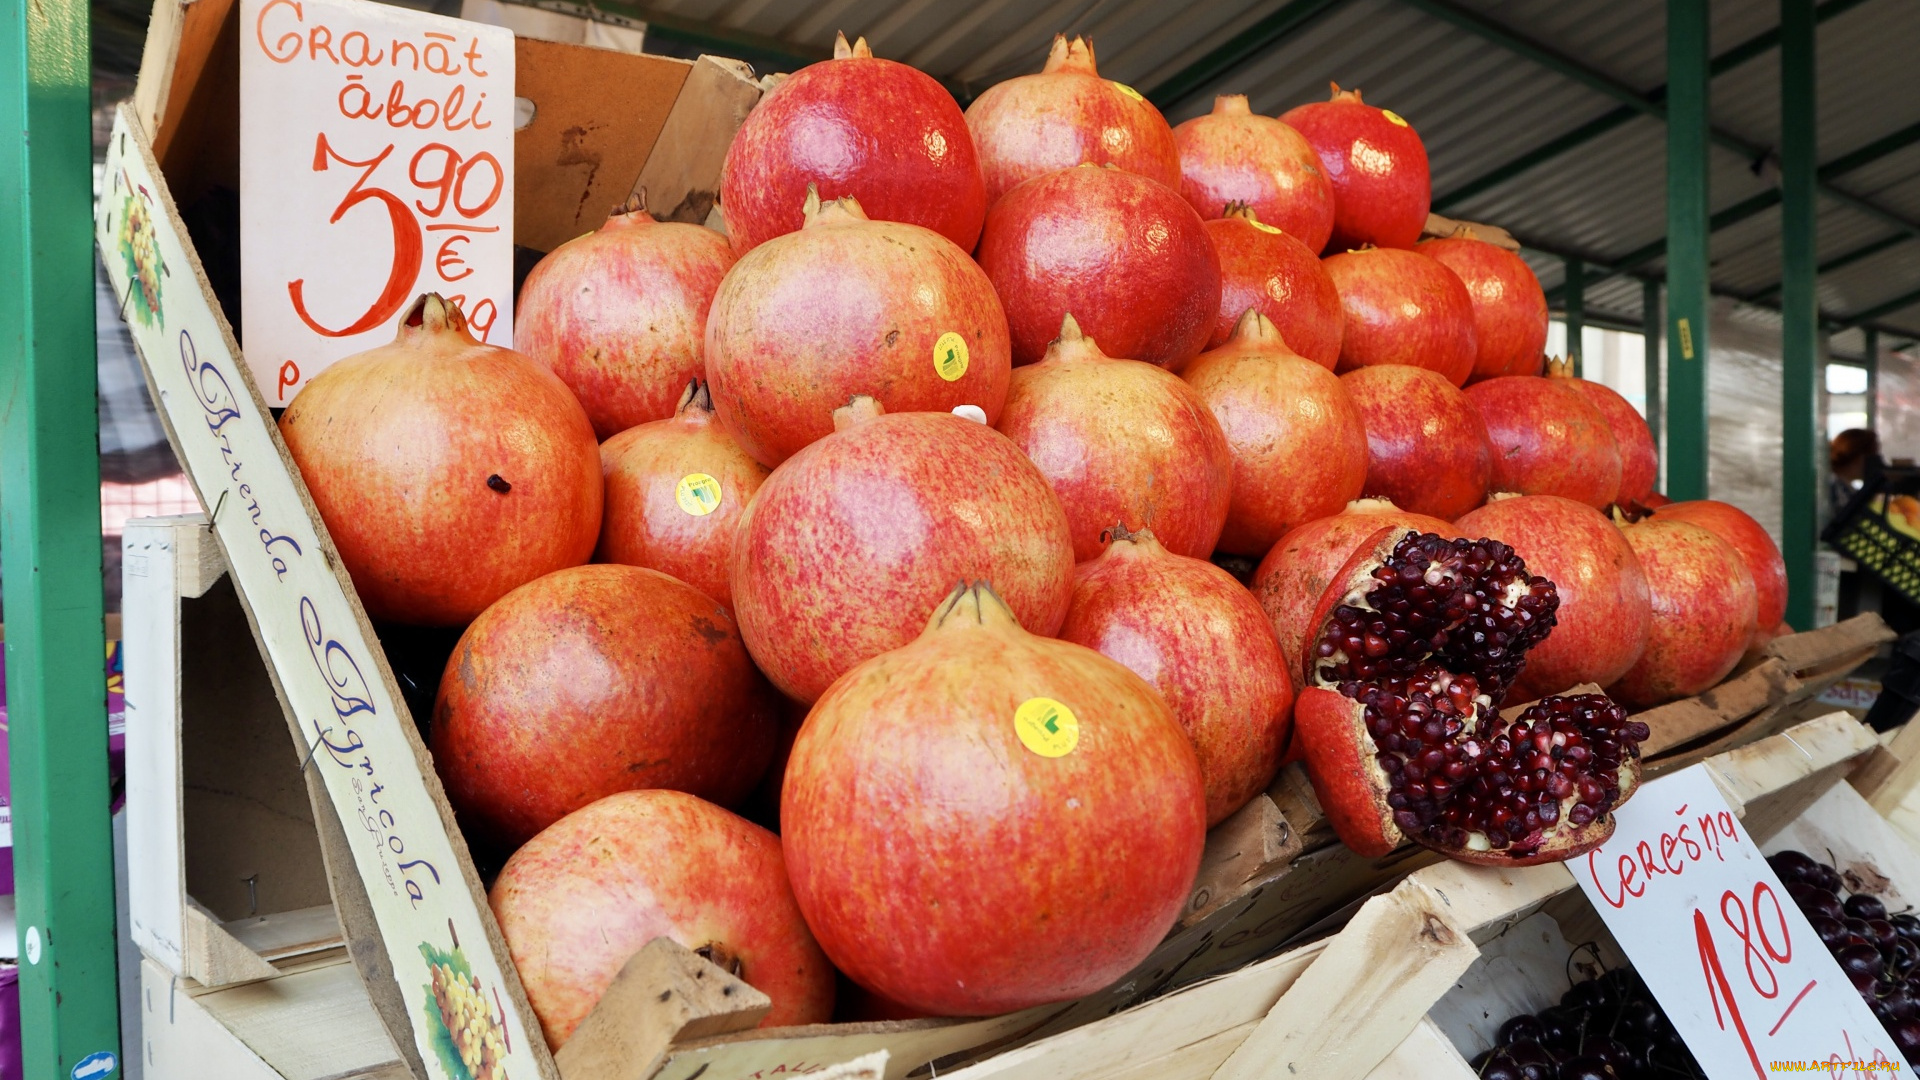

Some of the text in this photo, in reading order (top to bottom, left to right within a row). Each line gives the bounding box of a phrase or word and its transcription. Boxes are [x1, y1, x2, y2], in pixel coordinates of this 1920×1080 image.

[338, 75, 492, 132] āboli
[179, 329, 441, 911] Azienda Agricola
